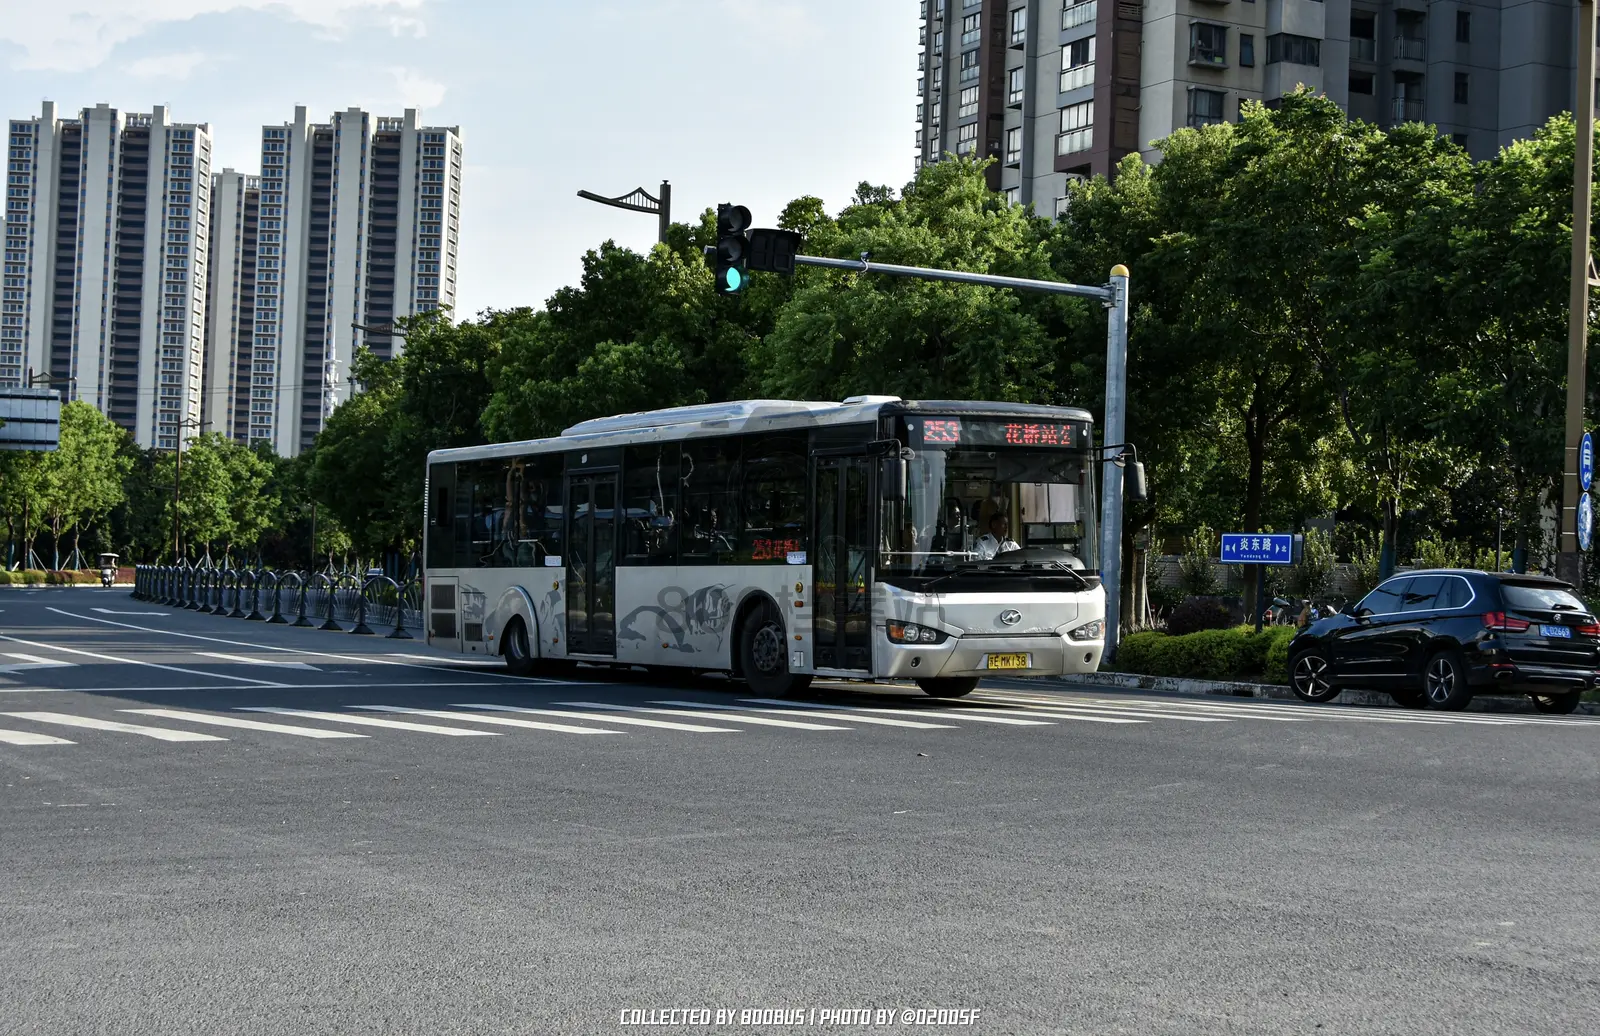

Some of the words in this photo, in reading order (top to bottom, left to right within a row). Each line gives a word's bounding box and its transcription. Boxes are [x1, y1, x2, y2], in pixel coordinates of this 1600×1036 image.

[923, 420, 959, 442] 253
[1240, 537, 1272, 551] 炎东路
